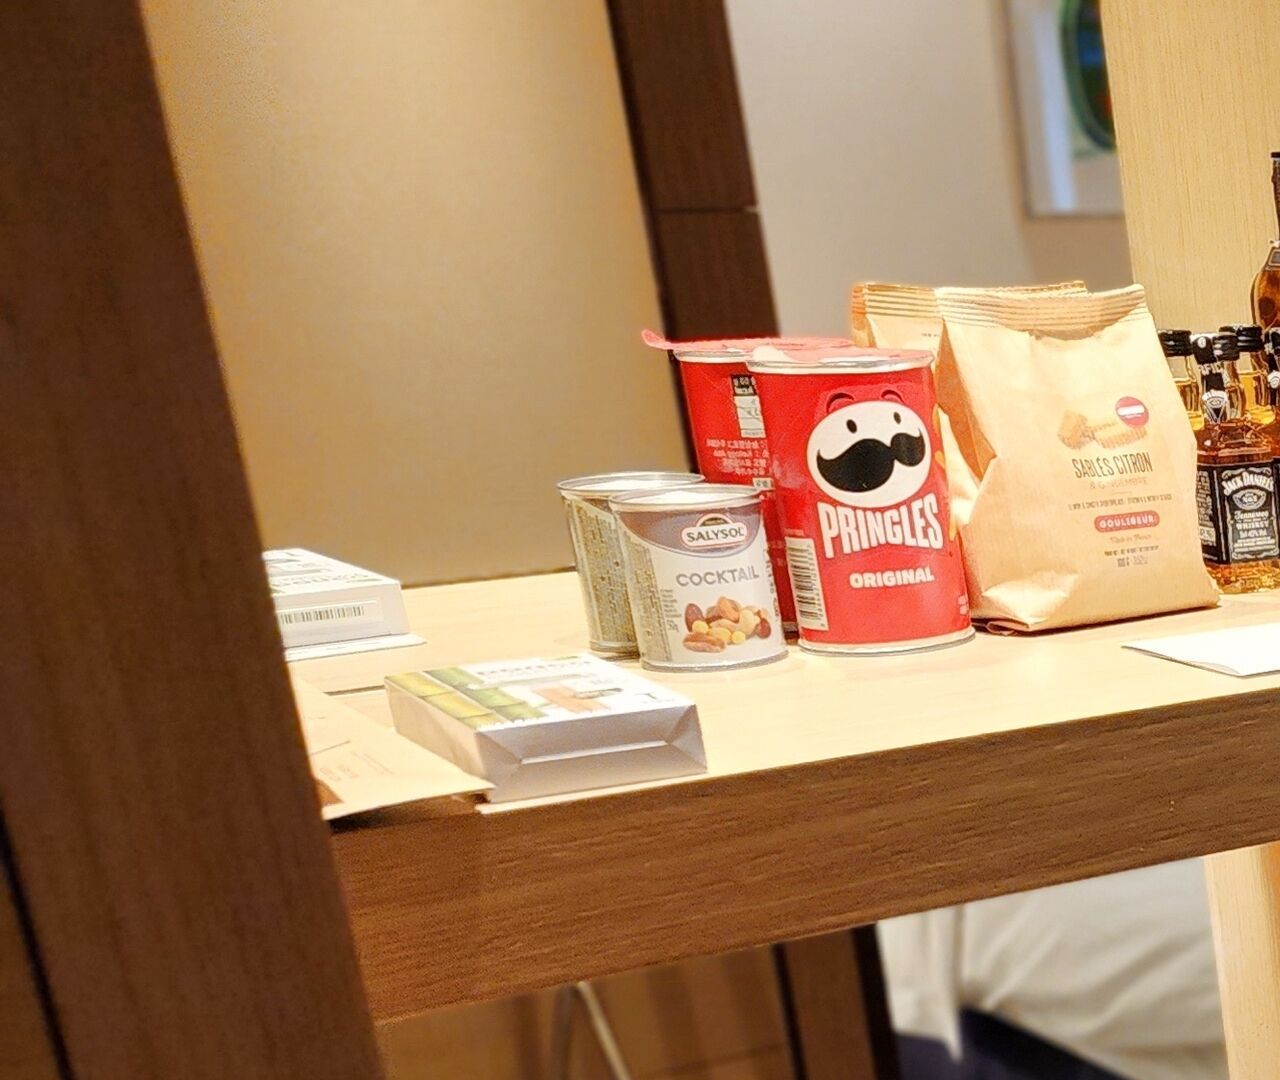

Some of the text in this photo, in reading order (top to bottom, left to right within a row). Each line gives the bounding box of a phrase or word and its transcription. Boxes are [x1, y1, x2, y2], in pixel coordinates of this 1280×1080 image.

[1071, 452, 1154, 479] SABLÉS CITRON
[1221, 474, 1247, 496] JACK
[686, 527, 745, 543] SALYSOL
[817, 492, 944, 559] PRINGLES
[675, 565, 760, 587] COCKTAIL
[849, 566, 935, 589] ORIGINAL
